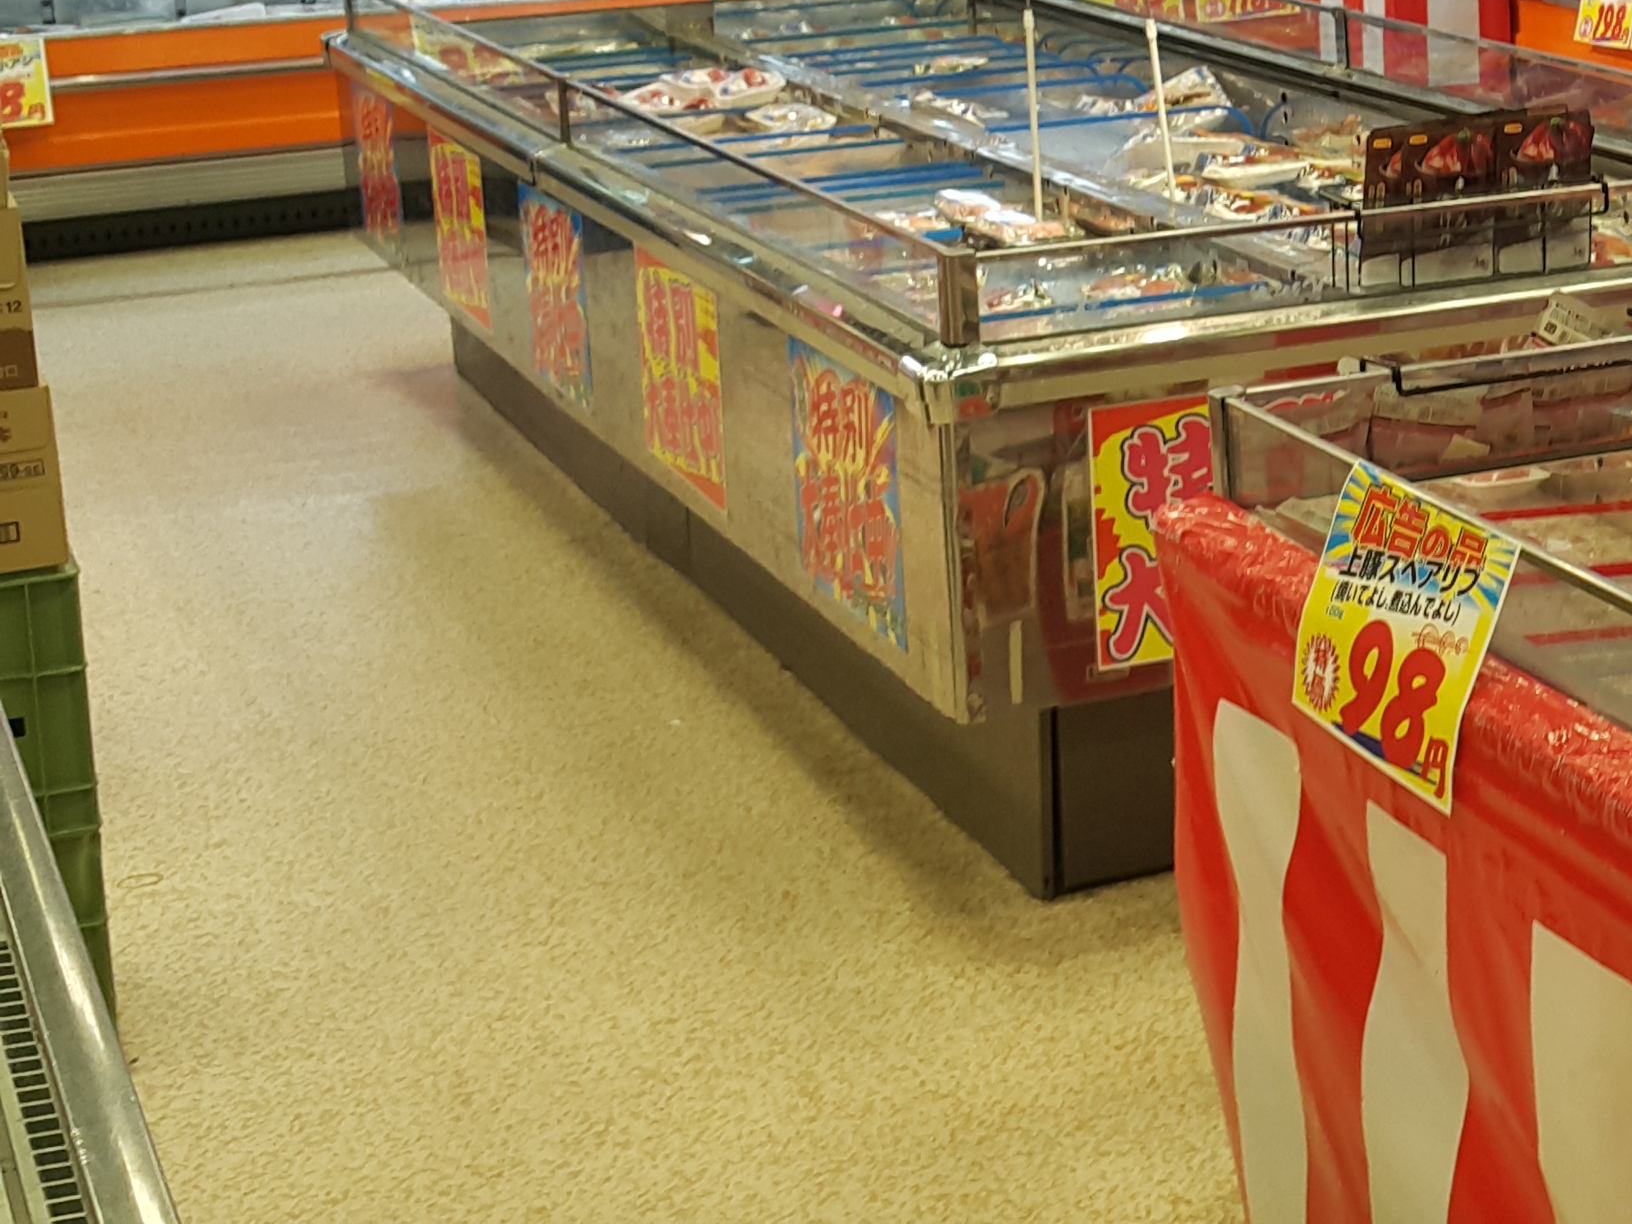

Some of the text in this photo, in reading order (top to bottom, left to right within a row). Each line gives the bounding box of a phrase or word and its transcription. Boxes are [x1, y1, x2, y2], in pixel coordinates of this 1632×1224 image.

[1351, 482, 1489, 571] 広告の品
[1338, 618, 1449, 801] 98円
